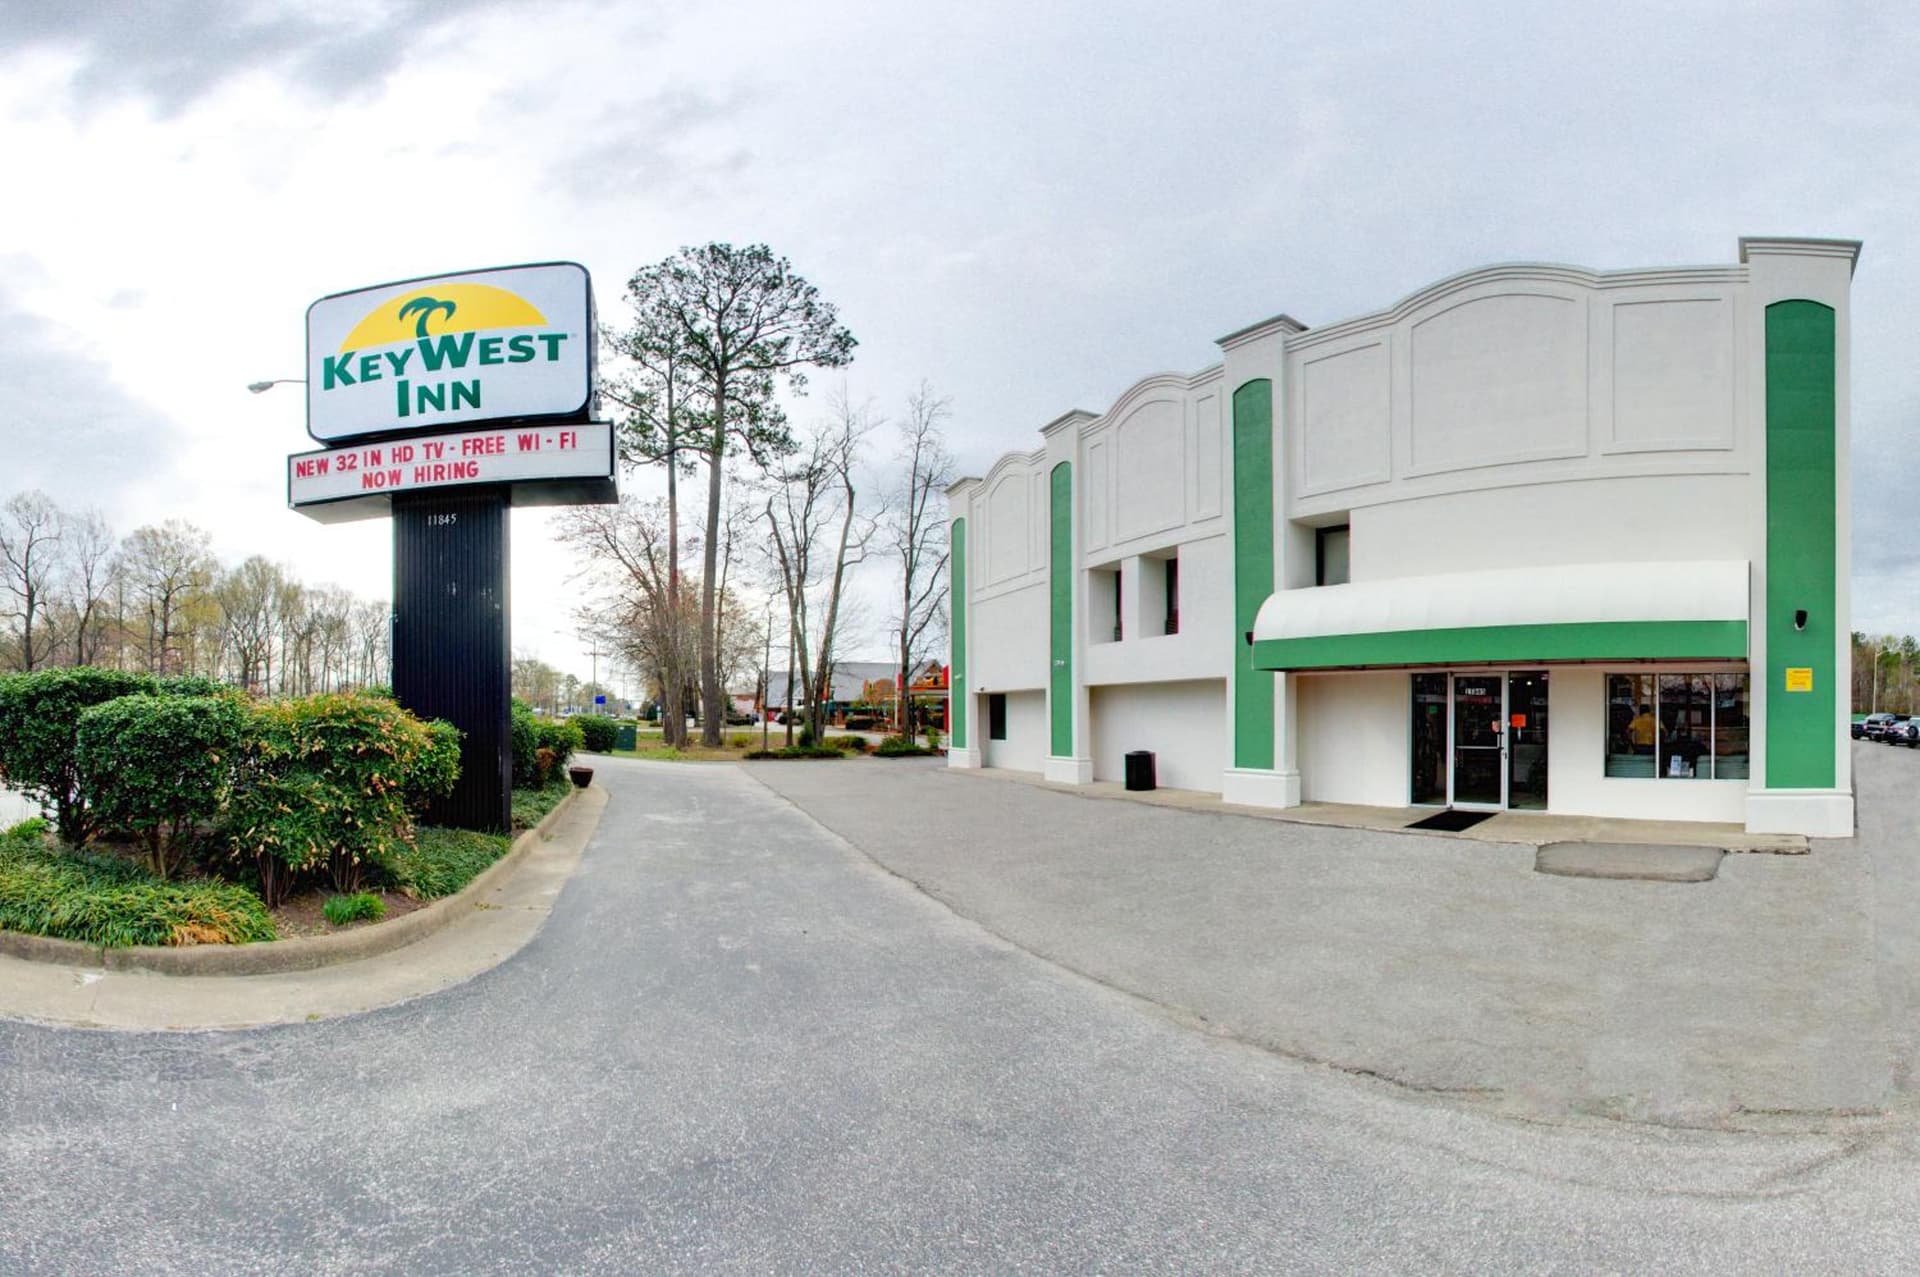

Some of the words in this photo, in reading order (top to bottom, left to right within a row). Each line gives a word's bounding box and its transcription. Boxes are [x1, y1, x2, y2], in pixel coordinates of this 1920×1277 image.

[397, 379, 481, 418] INN
[296, 458, 329, 478] NEW
[336, 453, 357, 471] 32
[363, 449, 382, 467] IN
[392, 445, 414, 464] HD
[462, 436, 505, 456] FREE
[362, 469, 401, 489] NOW
[414, 461, 479, 483] HIRING
[428, 513, 457, 526] 11845
